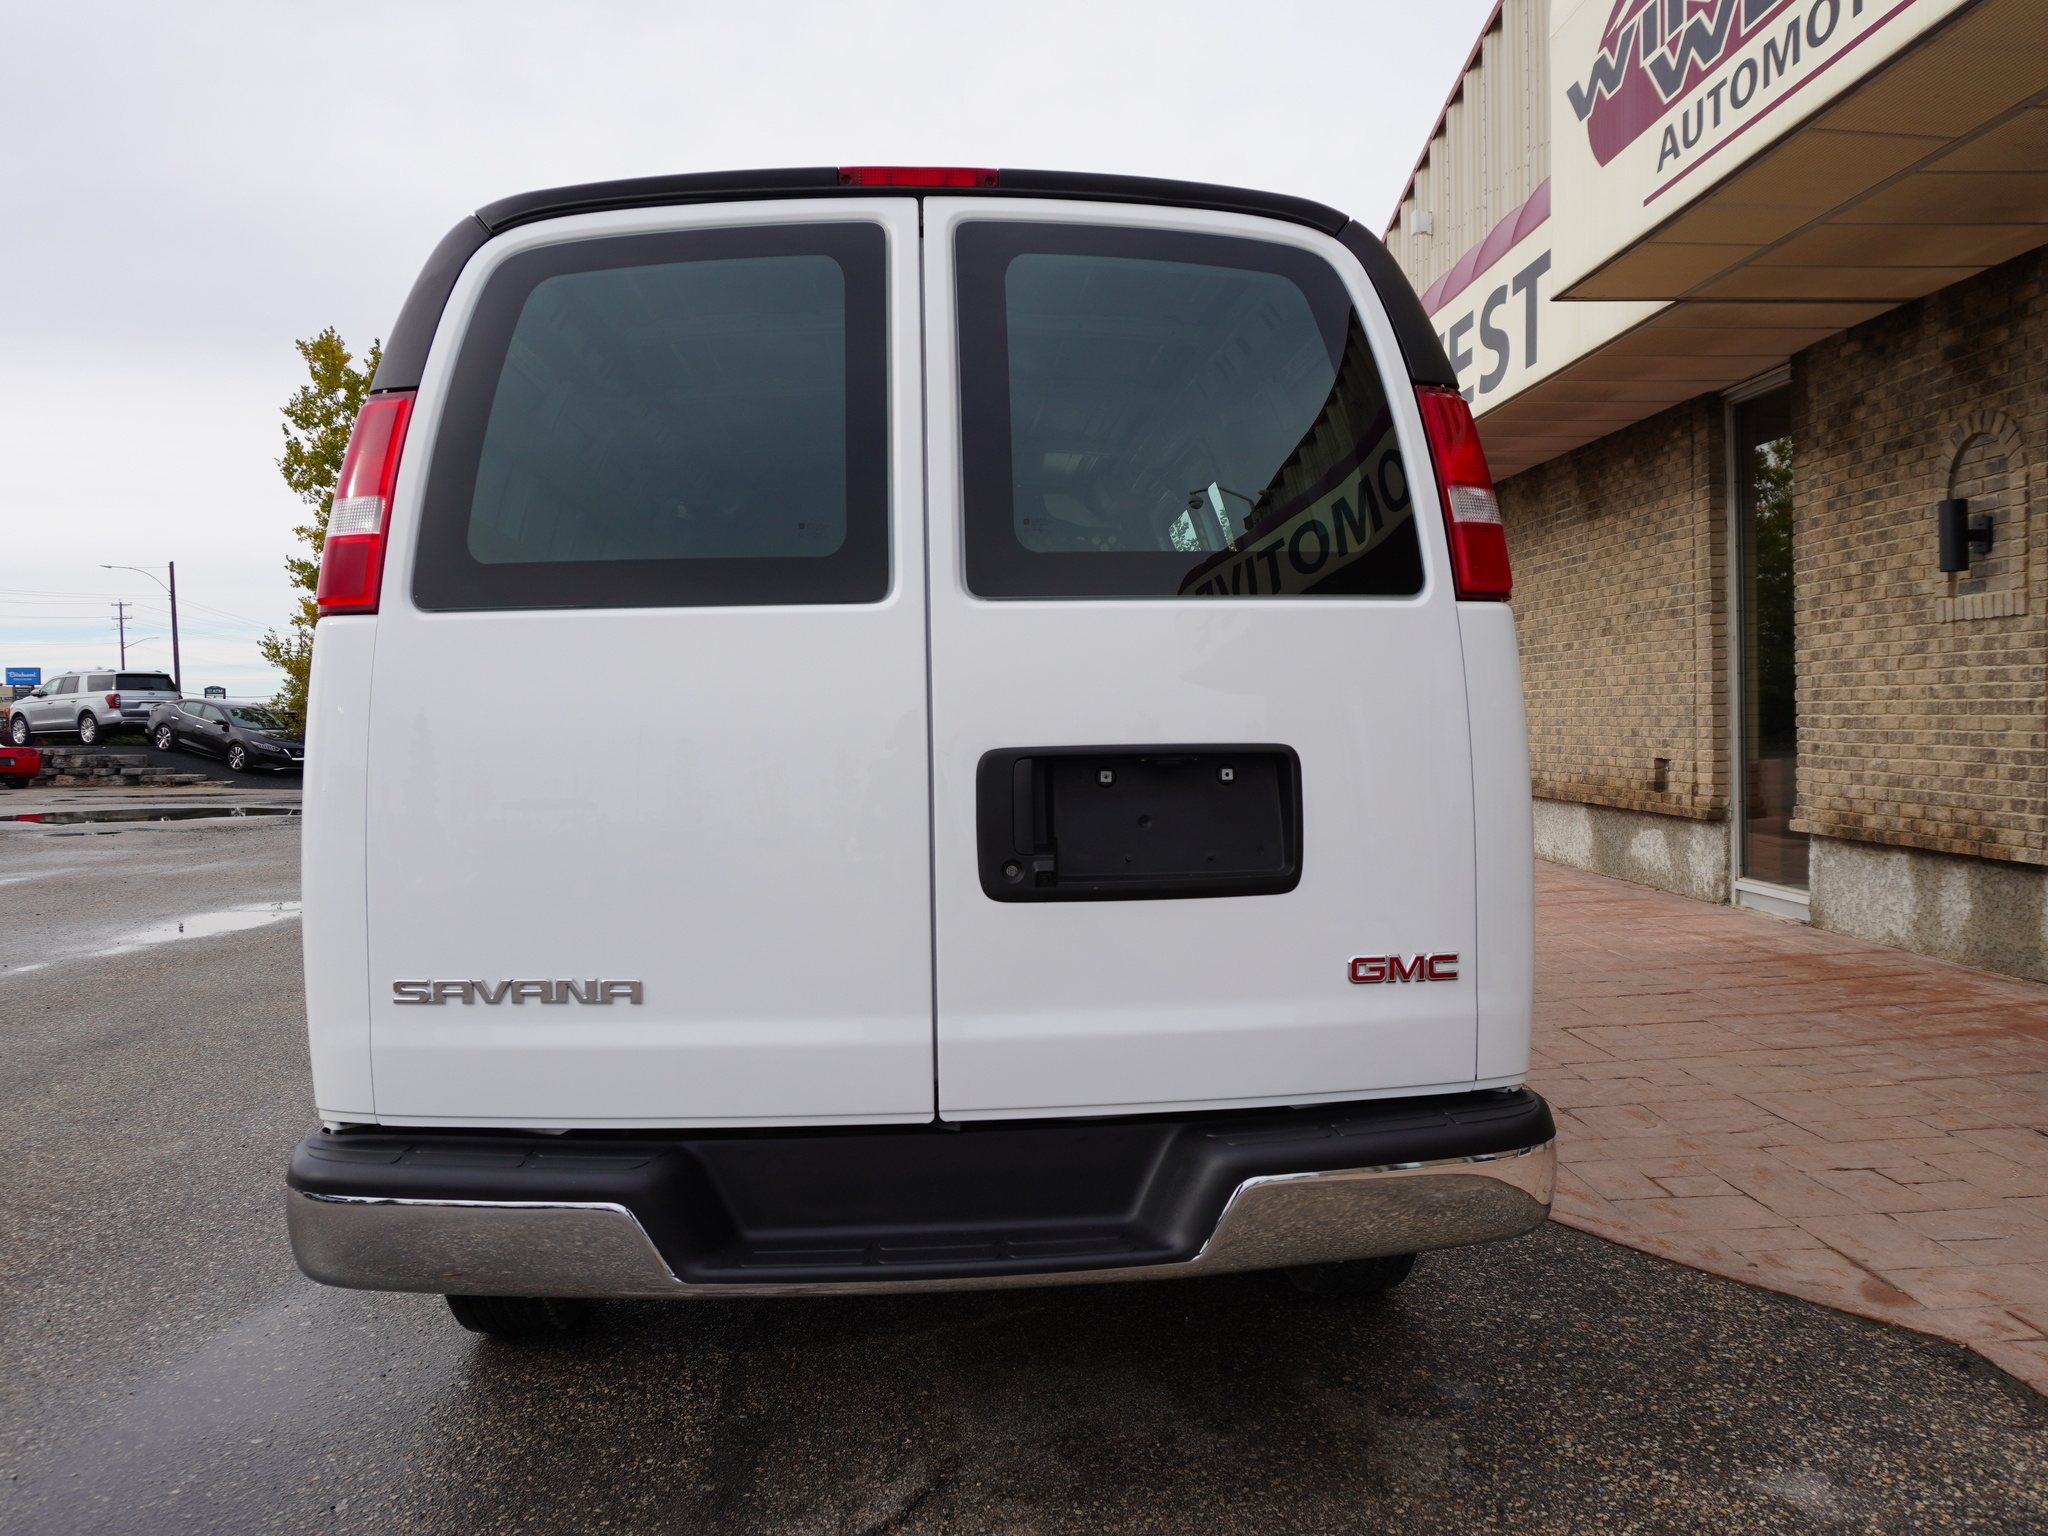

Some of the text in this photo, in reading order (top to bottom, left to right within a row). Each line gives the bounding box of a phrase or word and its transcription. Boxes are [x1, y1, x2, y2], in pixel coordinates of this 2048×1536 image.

[1439, 248, 1551, 404] EST
[1347, 951, 1459, 984] GMC
[393, 978, 643, 1005] SAVANA
